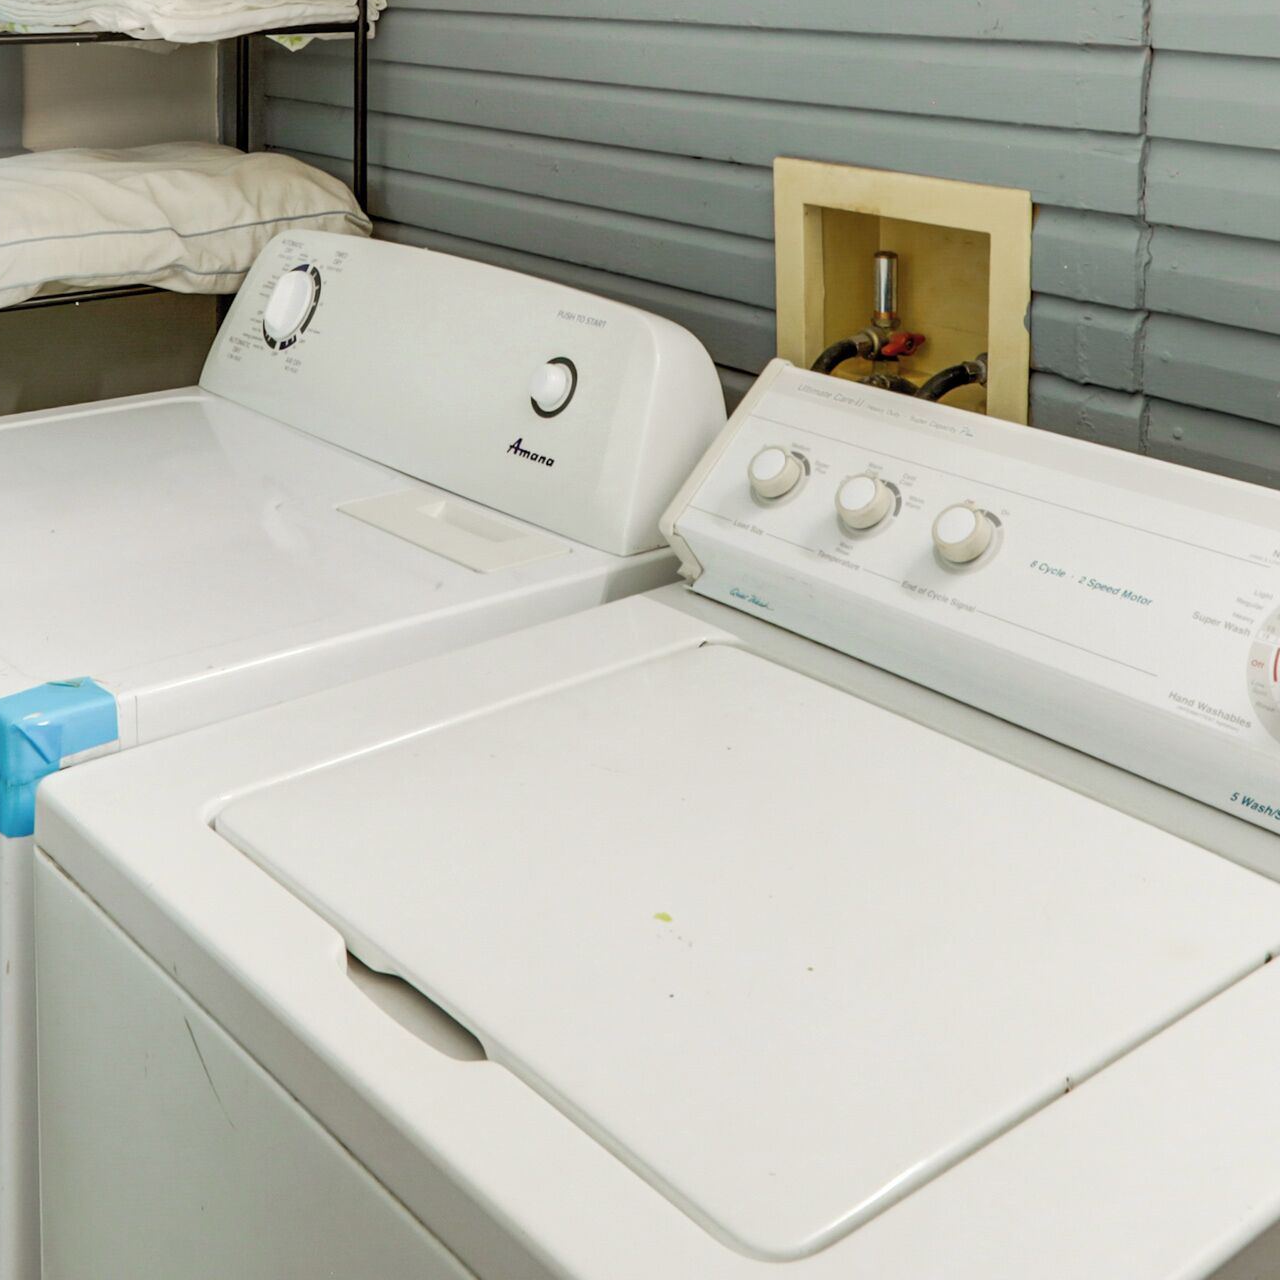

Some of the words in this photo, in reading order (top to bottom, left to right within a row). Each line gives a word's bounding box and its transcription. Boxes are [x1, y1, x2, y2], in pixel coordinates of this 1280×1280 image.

[557, 310, 576, 320] PUSH
[576, 314, 585, 323] TO
[585, 317, 607, 328] START
[507, 437, 555, 467] Amana
[817, 550, 861, 570] Temperature
[901, 580, 916, 592] End
[927, 589, 949, 604] Cycle
[950, 596, 976, 613] Signal
[1038, 562, 1067, 578] Cycle
[1077, 575, 1087, 585] 2
[1086, 578, 1120, 596] Speed
[1120, 589, 1154, 607] Motor
[1253, 588, 1274, 600] Light
[1192, 610, 1222, 626] Super
[1223, 620, 1251, 638] Wash
[1250, 658, 1265, 669] Off
[1168, 690, 1195, 708] Hand
[1197, 701, 1252, 729] Washables
[1229, 791, 1240, 802] 5
